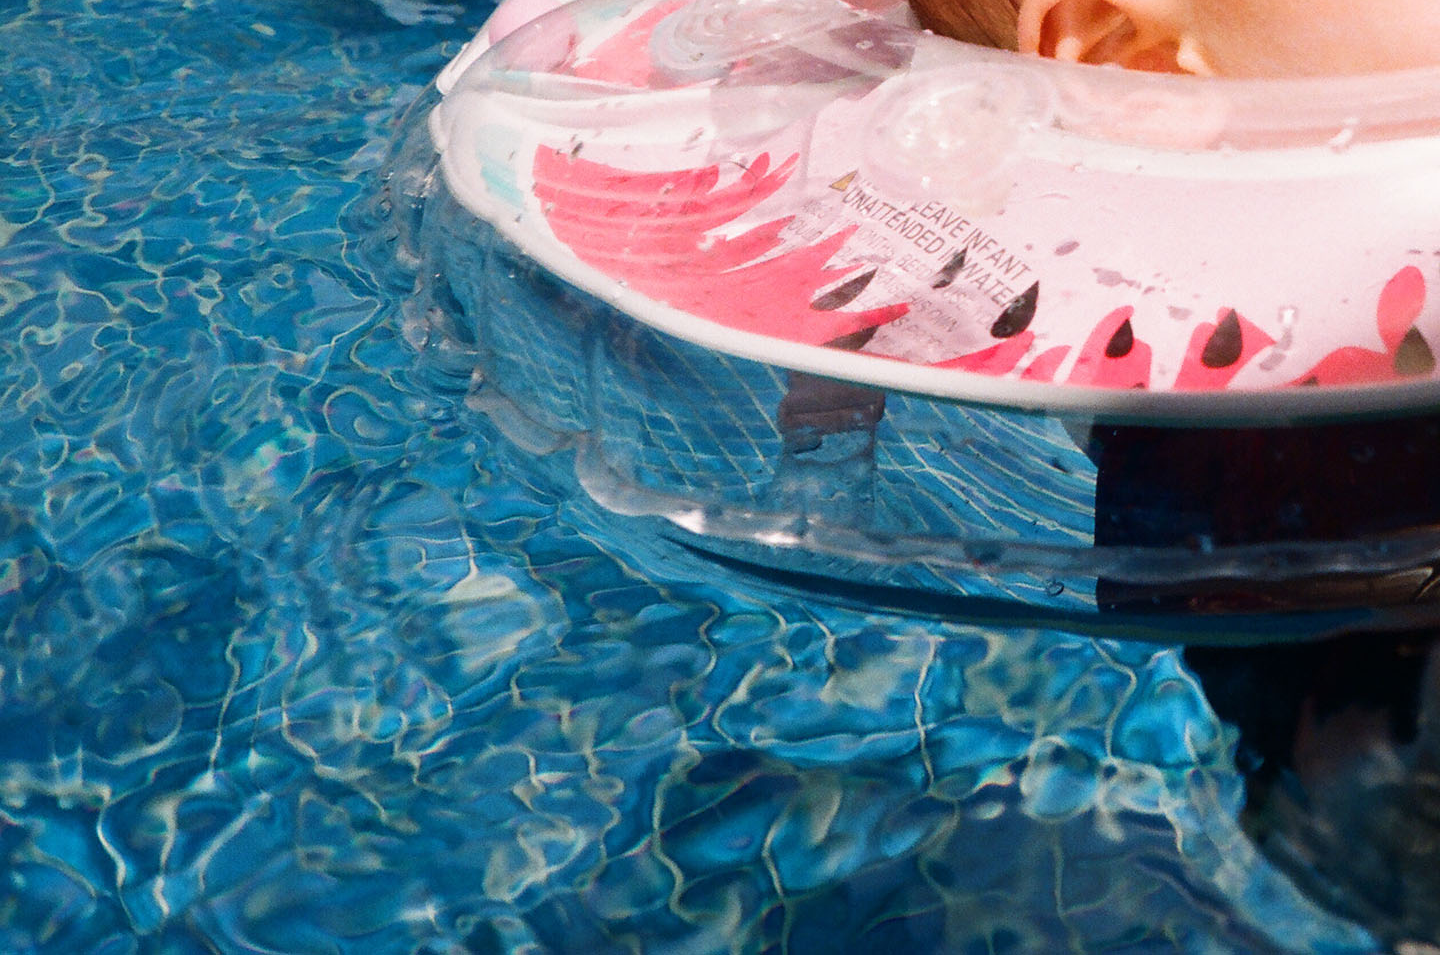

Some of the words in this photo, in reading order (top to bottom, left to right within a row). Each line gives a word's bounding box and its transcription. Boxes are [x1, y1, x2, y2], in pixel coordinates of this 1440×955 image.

[841, 186, 945, 254] UNATTENDED
[962, 256, 1014, 308] WATE
[908, 199, 971, 239] LEAVE
[962, 227, 1031, 282] INFANT
